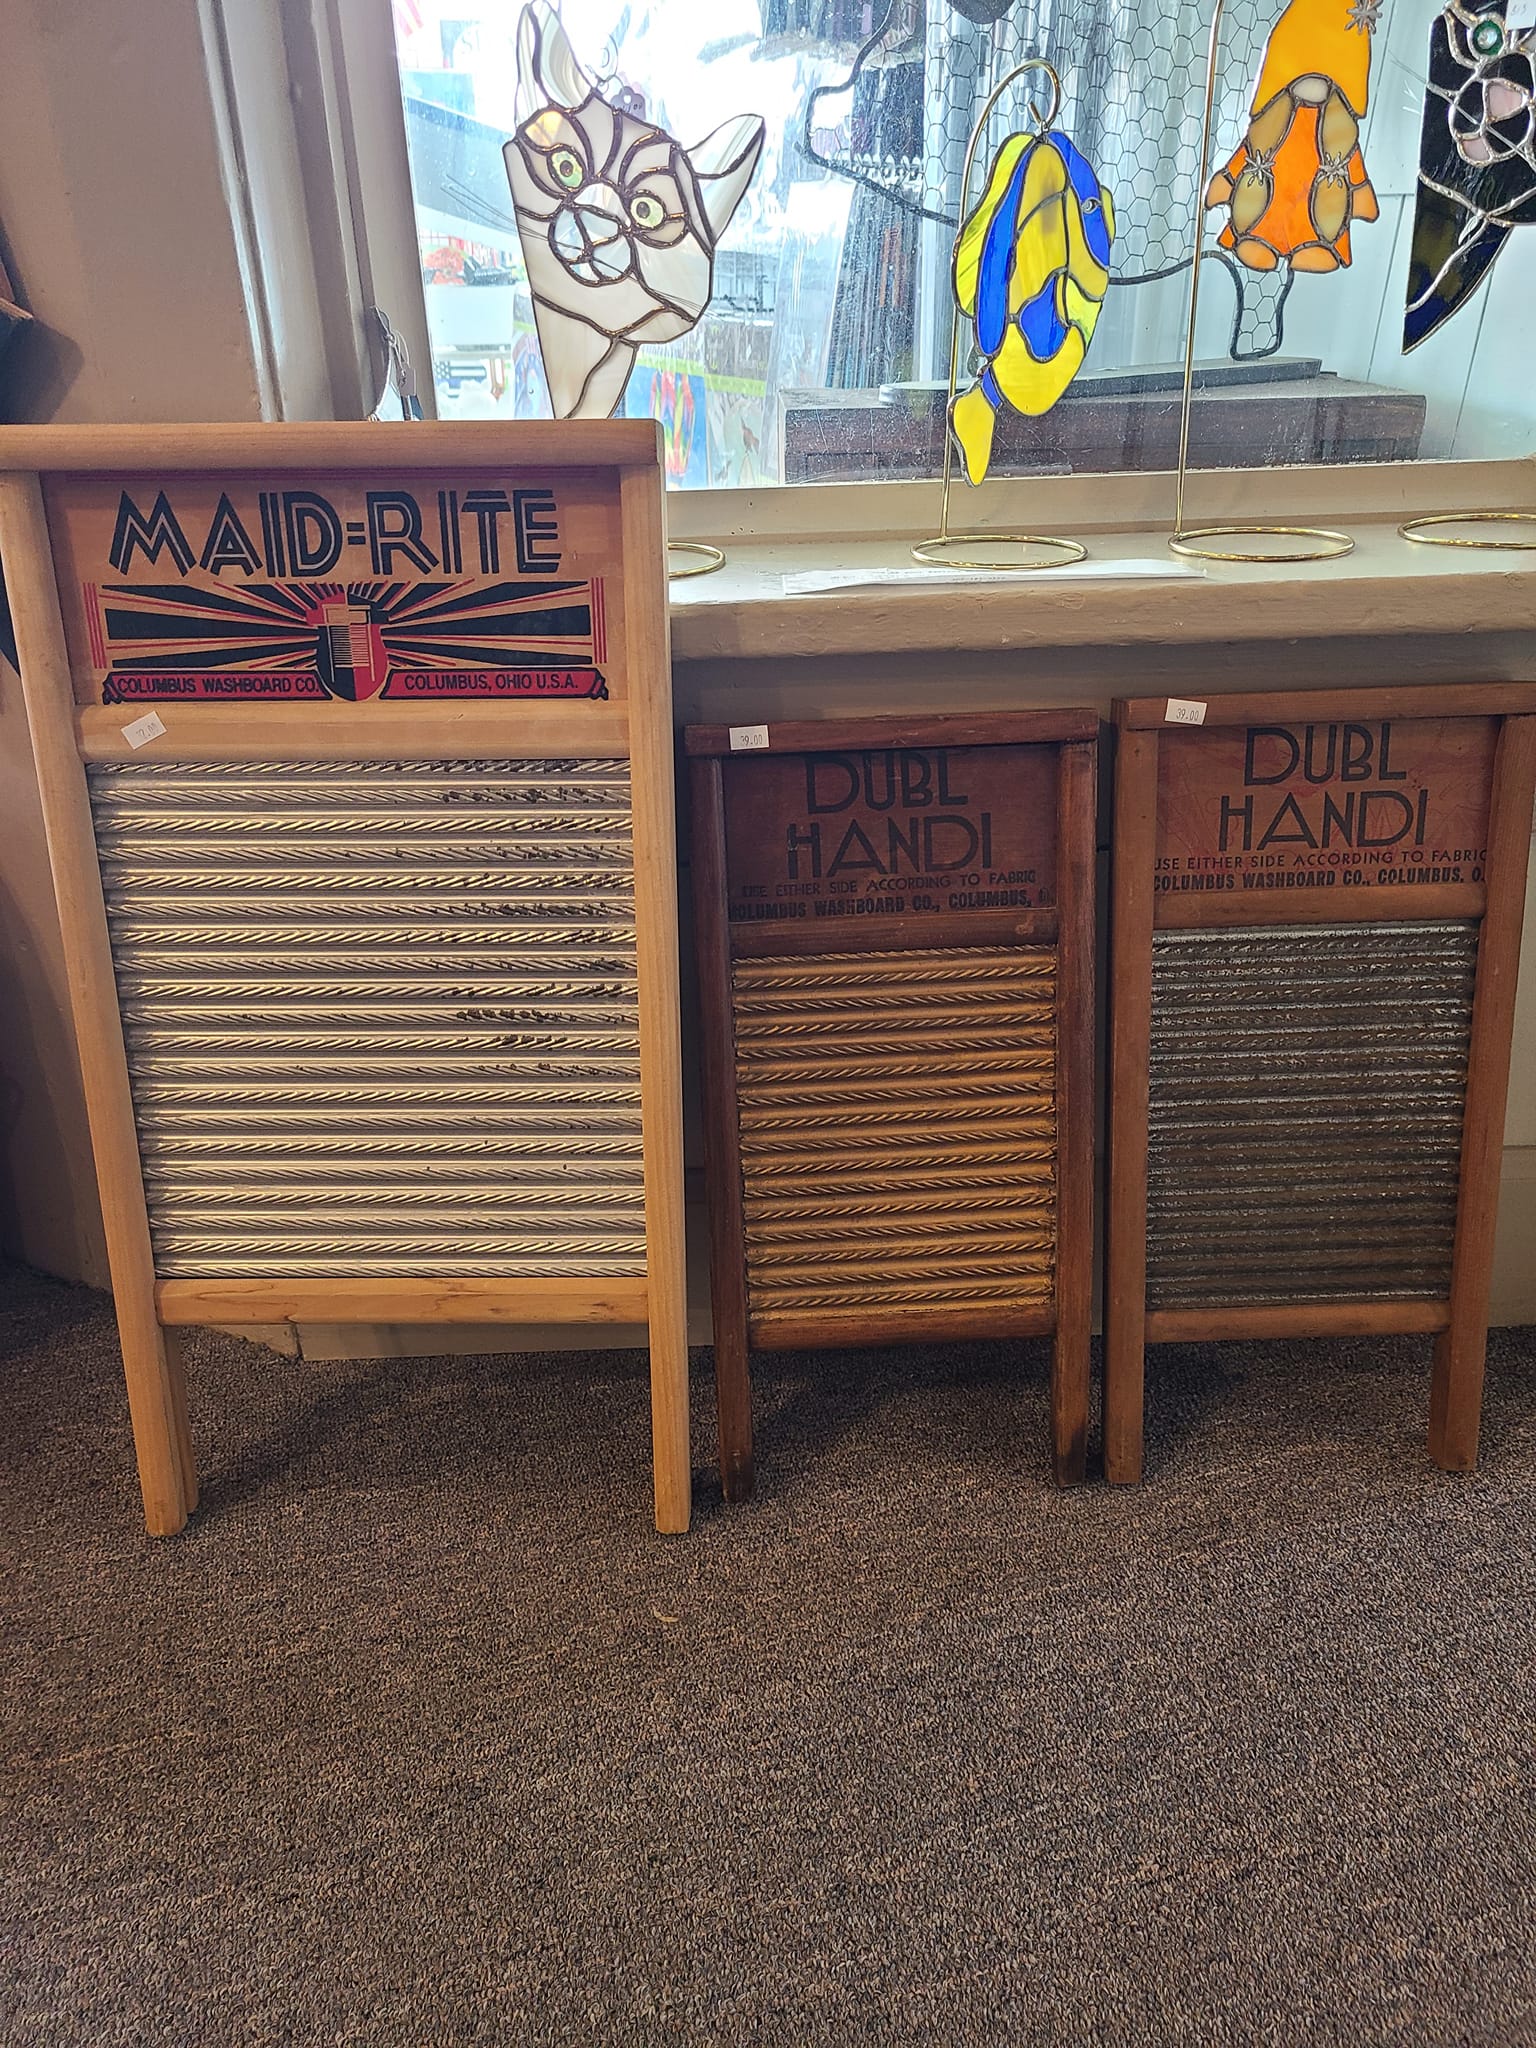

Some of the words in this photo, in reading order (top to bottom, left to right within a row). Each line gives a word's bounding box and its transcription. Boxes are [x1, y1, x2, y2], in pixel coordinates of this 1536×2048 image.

[117, 678, 196, 694] COLUMBUS
[202, 678, 291, 693] WASHBOARD
[295, 677, 320, 692] CO.
[404, 674, 492, 691] COLUMBUS,
[495, 674, 532, 689] OHIO
[536, 674, 578, 689] U.S.A.
[1176, 707, 1200, 721] 39.00
[1244, 721, 1407, 787] DUBL
[804, 750, 969, 815] DUBL
[1218, 788, 1429, 852] HANDI
[787, 812, 992, 880] HANDI
[1154, 857, 1180, 870] USE
[1187, 856, 1243, 870] EITHER
[1250, 854, 1285, 867] SIDE
[1293, 851, 1393, 867] ACCORDING
[1401, 850, 1424, 863] TO
[1431, 849, 1486, 862] FABRIC
[776, 883, 821, 897] EITHER
[830, 880, 858, 894] SIDE
[866, 876, 950, 892] ACCORDING
[960, 873, 980, 886] TO
[989, 870, 1036, 885] FABRIC
[1154, 873, 1235, 891] COLUMBUS
[1242, 869, 1336, 888] WASHBOARD
[815, 896, 905, 916] WASHBOARD
[949, 889, 1032, 908] COLUMBUS,
